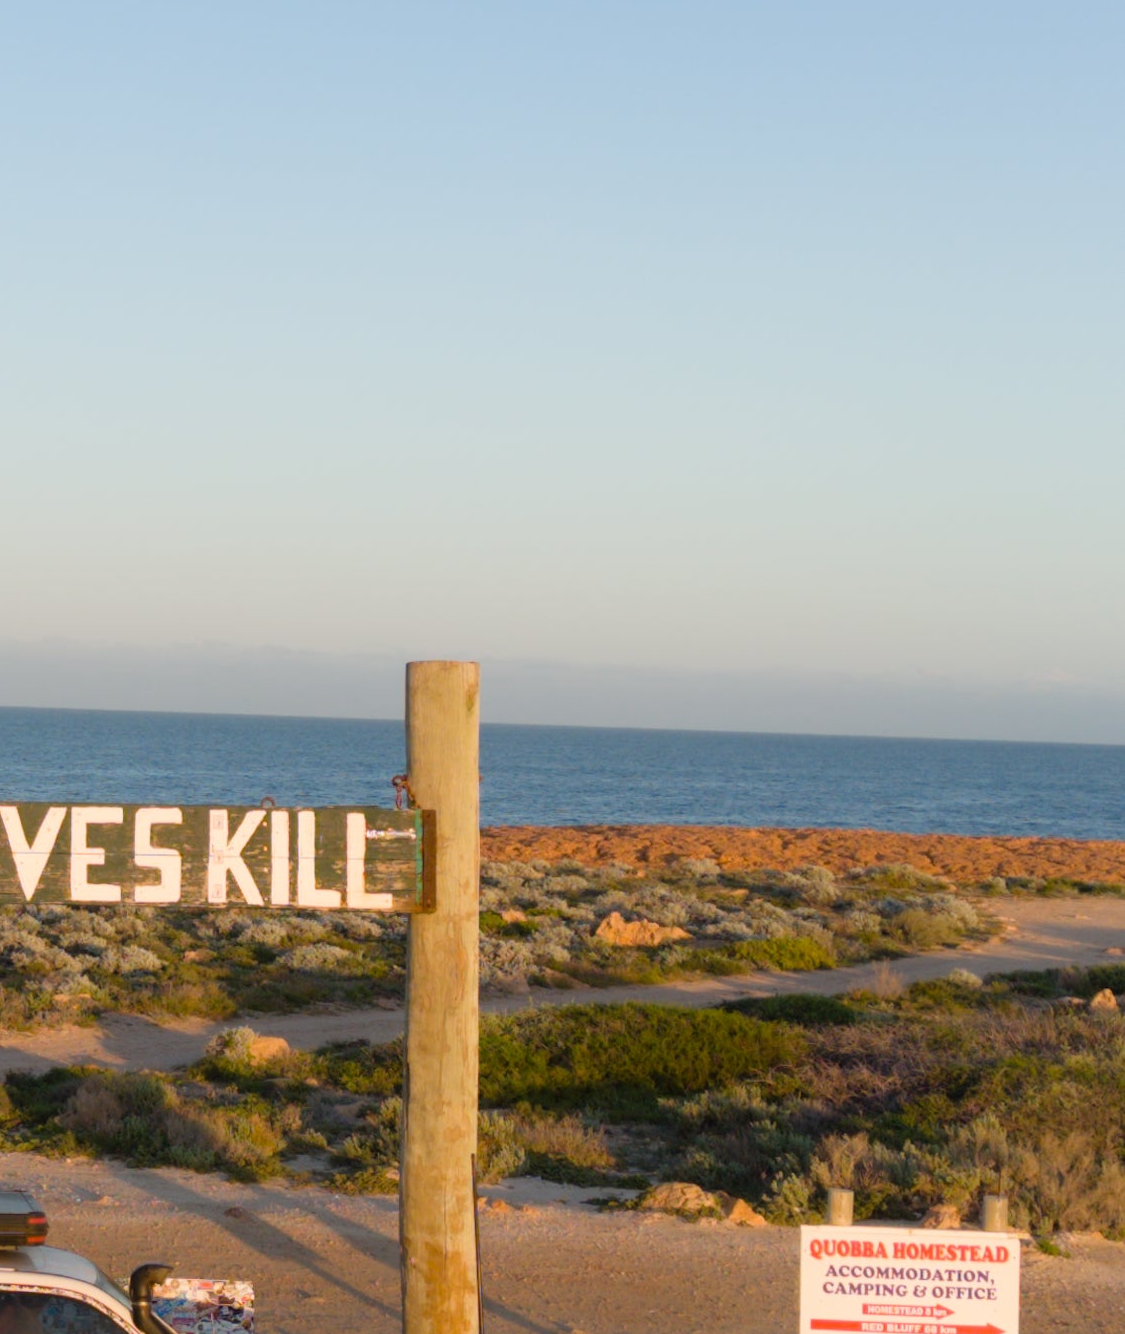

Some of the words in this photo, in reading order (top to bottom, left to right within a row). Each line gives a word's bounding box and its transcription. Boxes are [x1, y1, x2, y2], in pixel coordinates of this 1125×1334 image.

[208, 809, 393, 909] KILL
[810, 1239, 889, 1260] QUOBBA
[892, 1242, 1010, 1263] HOMESTEAD
[825, 1264, 995, 1285] ACCOMMODATION,
[822, 1281, 908, 1298] CAMPING
[912, 1284, 927, 1298] &
[931, 1286, 997, 1300] OFFICE
[867, 1305, 924, 1315] HOMESTEAD
[933, 1307, 947, 1316] km
[861, 1322, 884, 1332] RED
[886, 1323, 922, 1333] BLUFF
[940, 1325, 957, 1334] km
